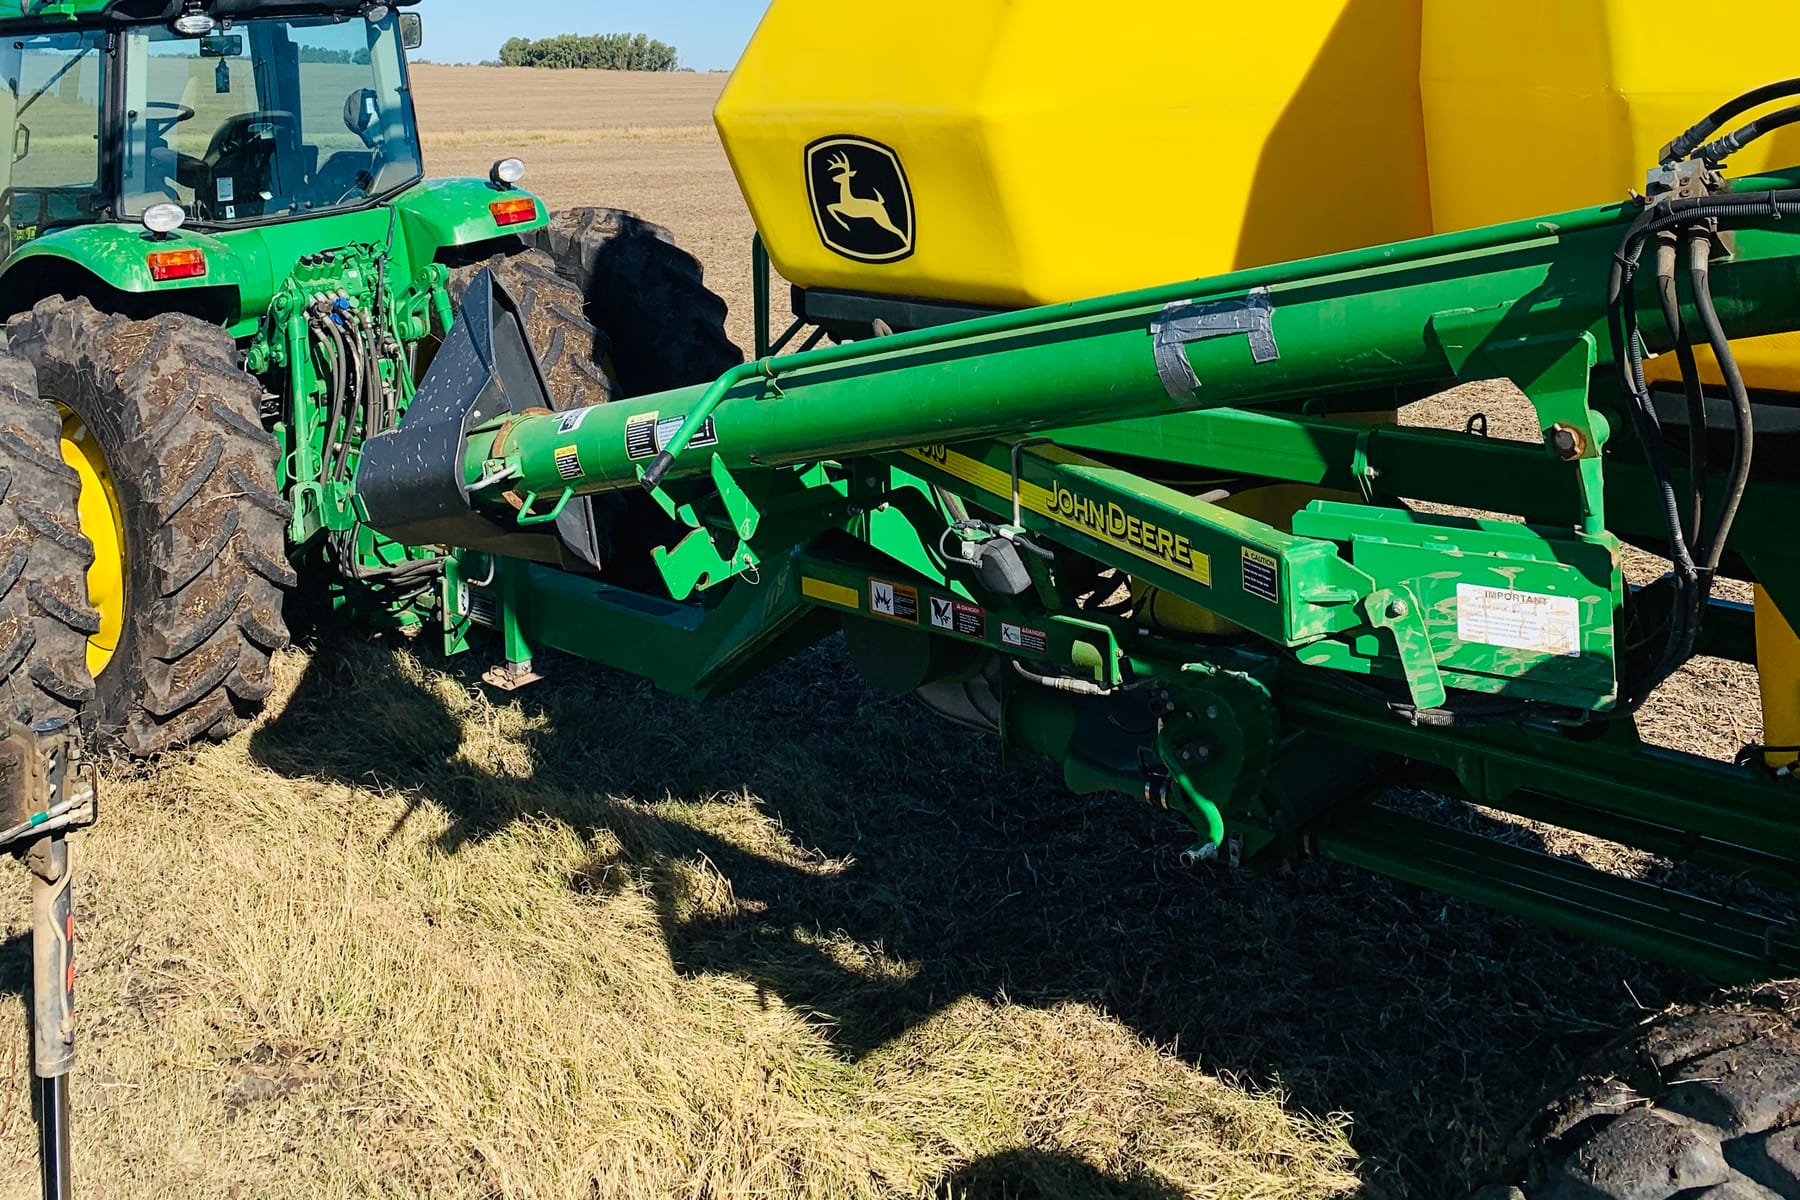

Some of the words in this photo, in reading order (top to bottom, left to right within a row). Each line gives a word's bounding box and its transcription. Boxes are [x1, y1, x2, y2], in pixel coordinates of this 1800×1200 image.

[1046, 479, 1105, 532] JOHN
[1106, 501, 1192, 566] DEERE
[1250, 552, 1275, 568] CAUTION
[1484, 590, 1547, 605] IMPORTANT
